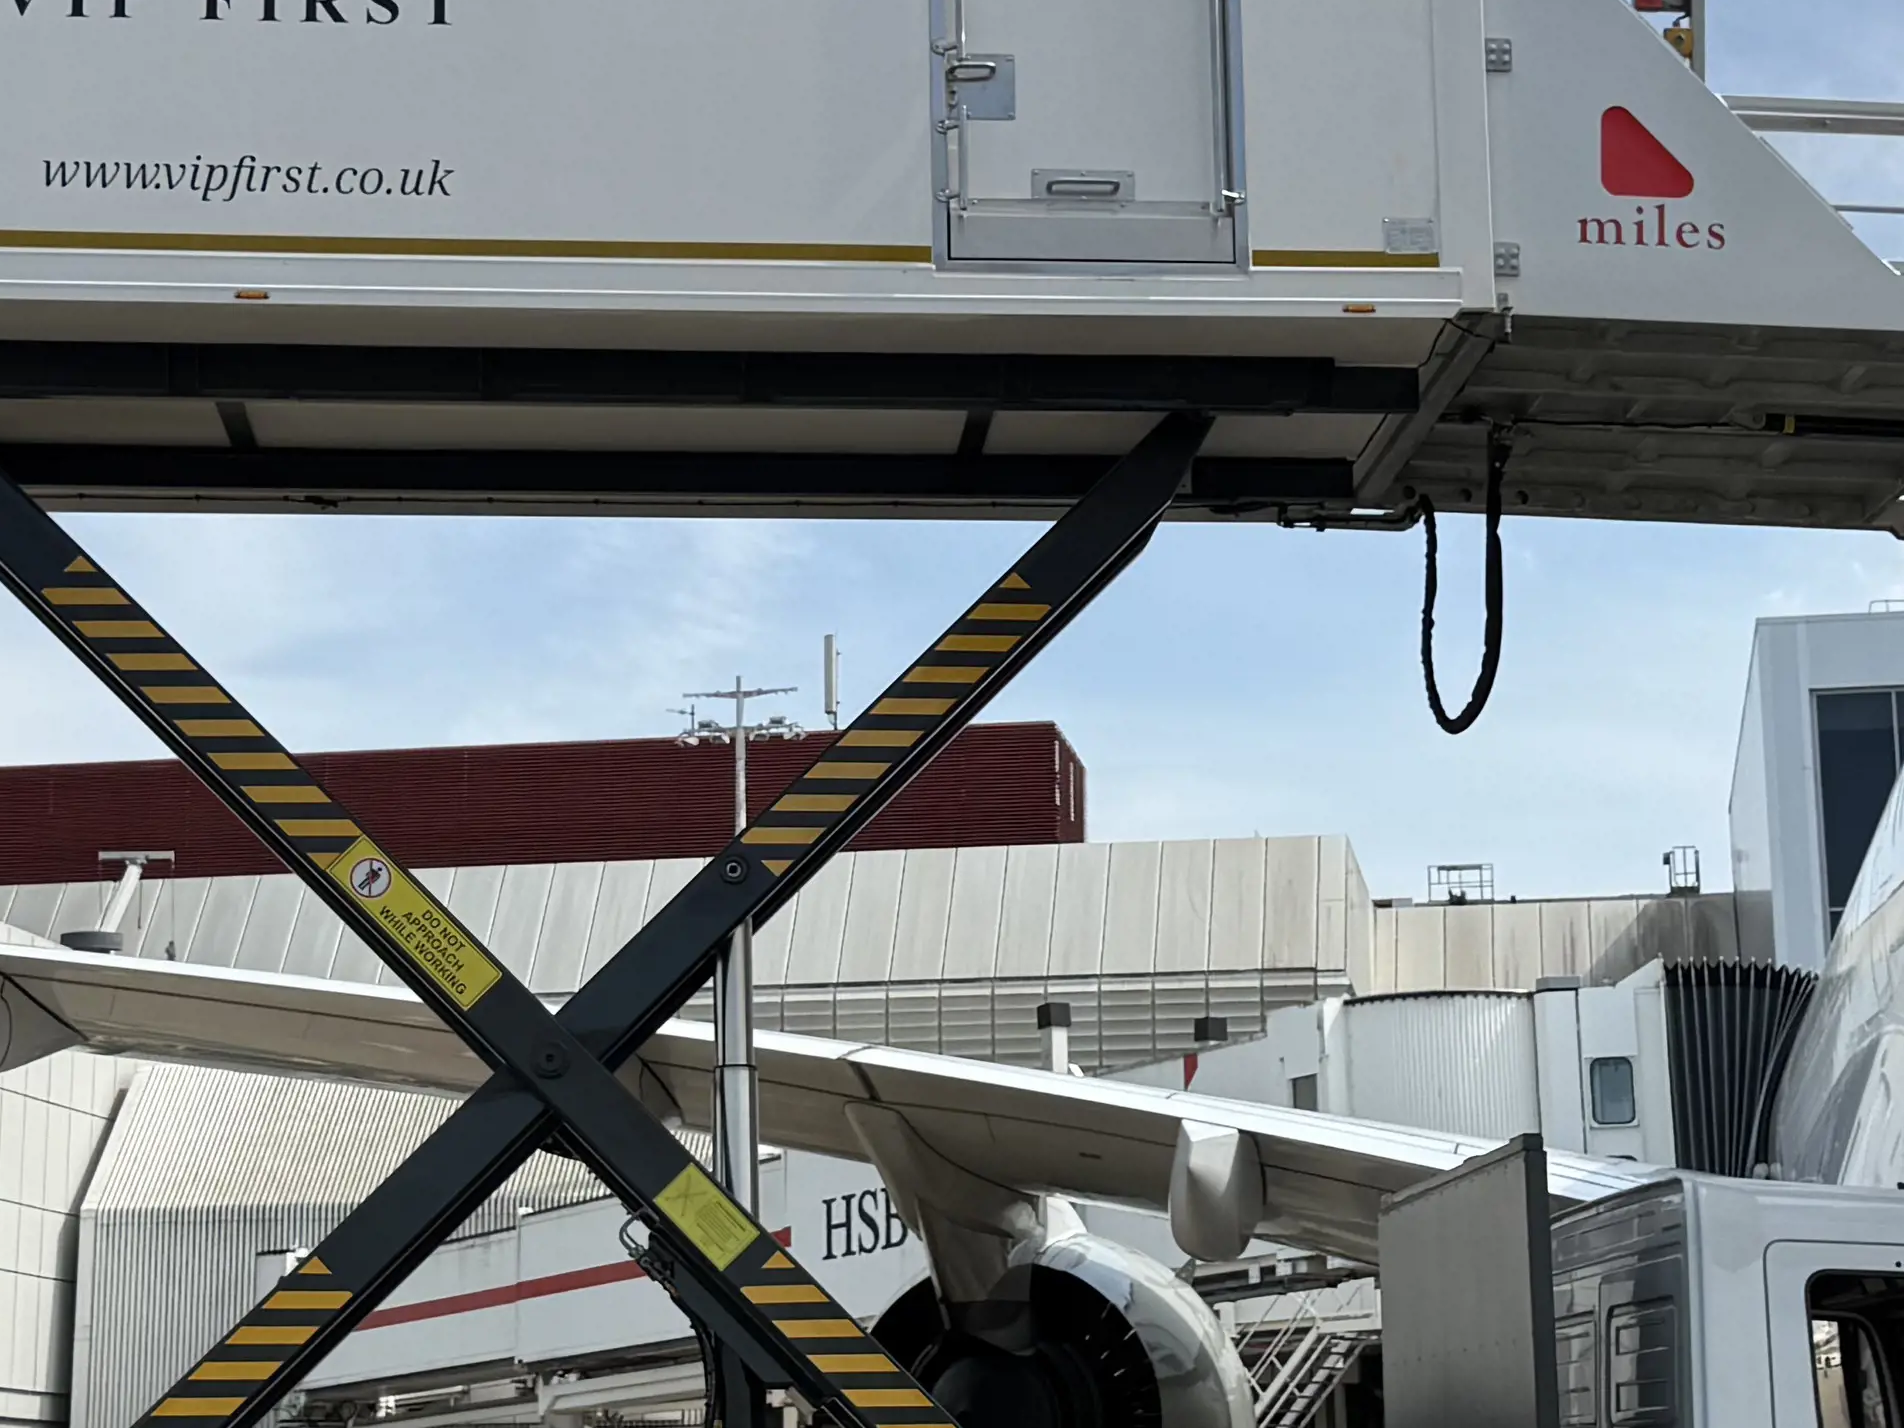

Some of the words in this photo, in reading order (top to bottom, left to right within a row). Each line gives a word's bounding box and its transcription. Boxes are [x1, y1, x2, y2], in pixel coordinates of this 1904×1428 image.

[42, 154, 456, 203] www.vipfirst.co.uk
[1577, 203, 1726, 251] miles
[379, 905, 417, 944] WHILE
[414, 941, 468, 996] WORKING
[401, 911, 465, 973] APPROACH
[421, 909, 442, 929] DO
[439, 927, 467, 953] NOT
